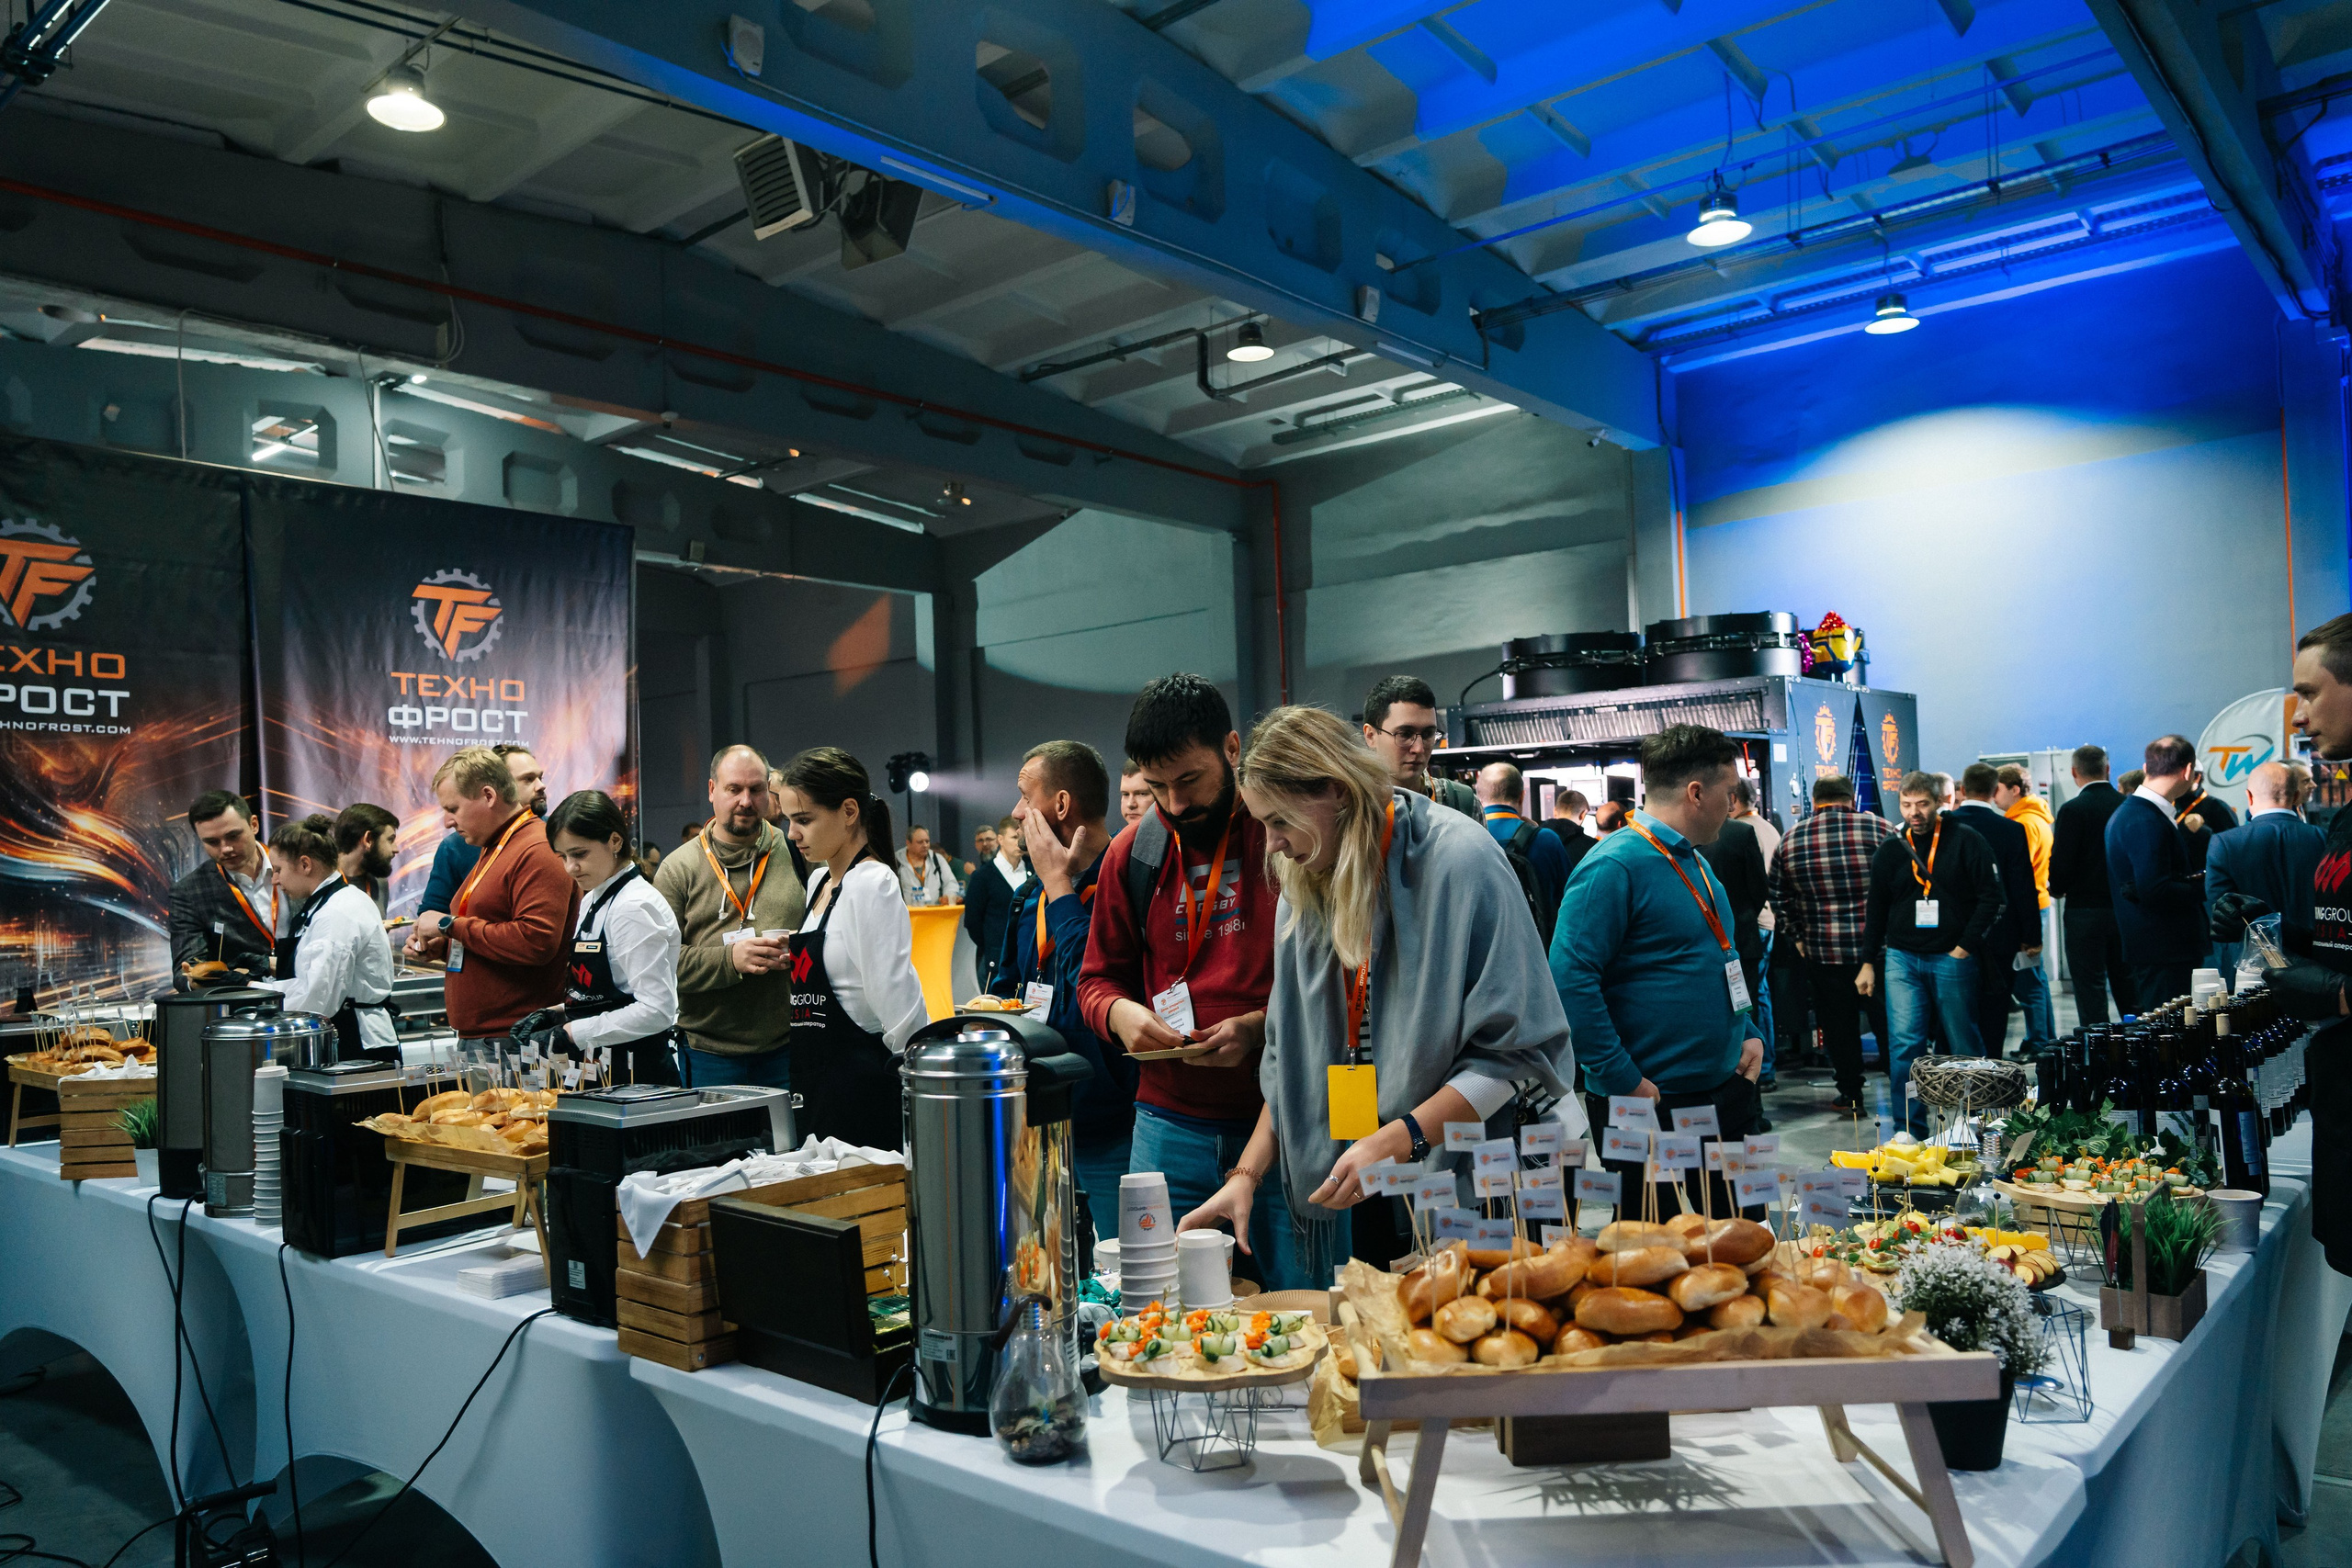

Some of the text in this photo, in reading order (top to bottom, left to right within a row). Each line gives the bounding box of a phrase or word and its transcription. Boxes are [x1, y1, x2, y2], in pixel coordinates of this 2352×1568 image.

[0, 645, 126, 679] ХНО
[390, 671, 525, 702] ТЕХНО
[388, 705, 528, 734] ФРОСТ
[389, 735, 529, 747] WWW.TEHNOFROSTCOM
[1176, 928, 1213, 942] sie
